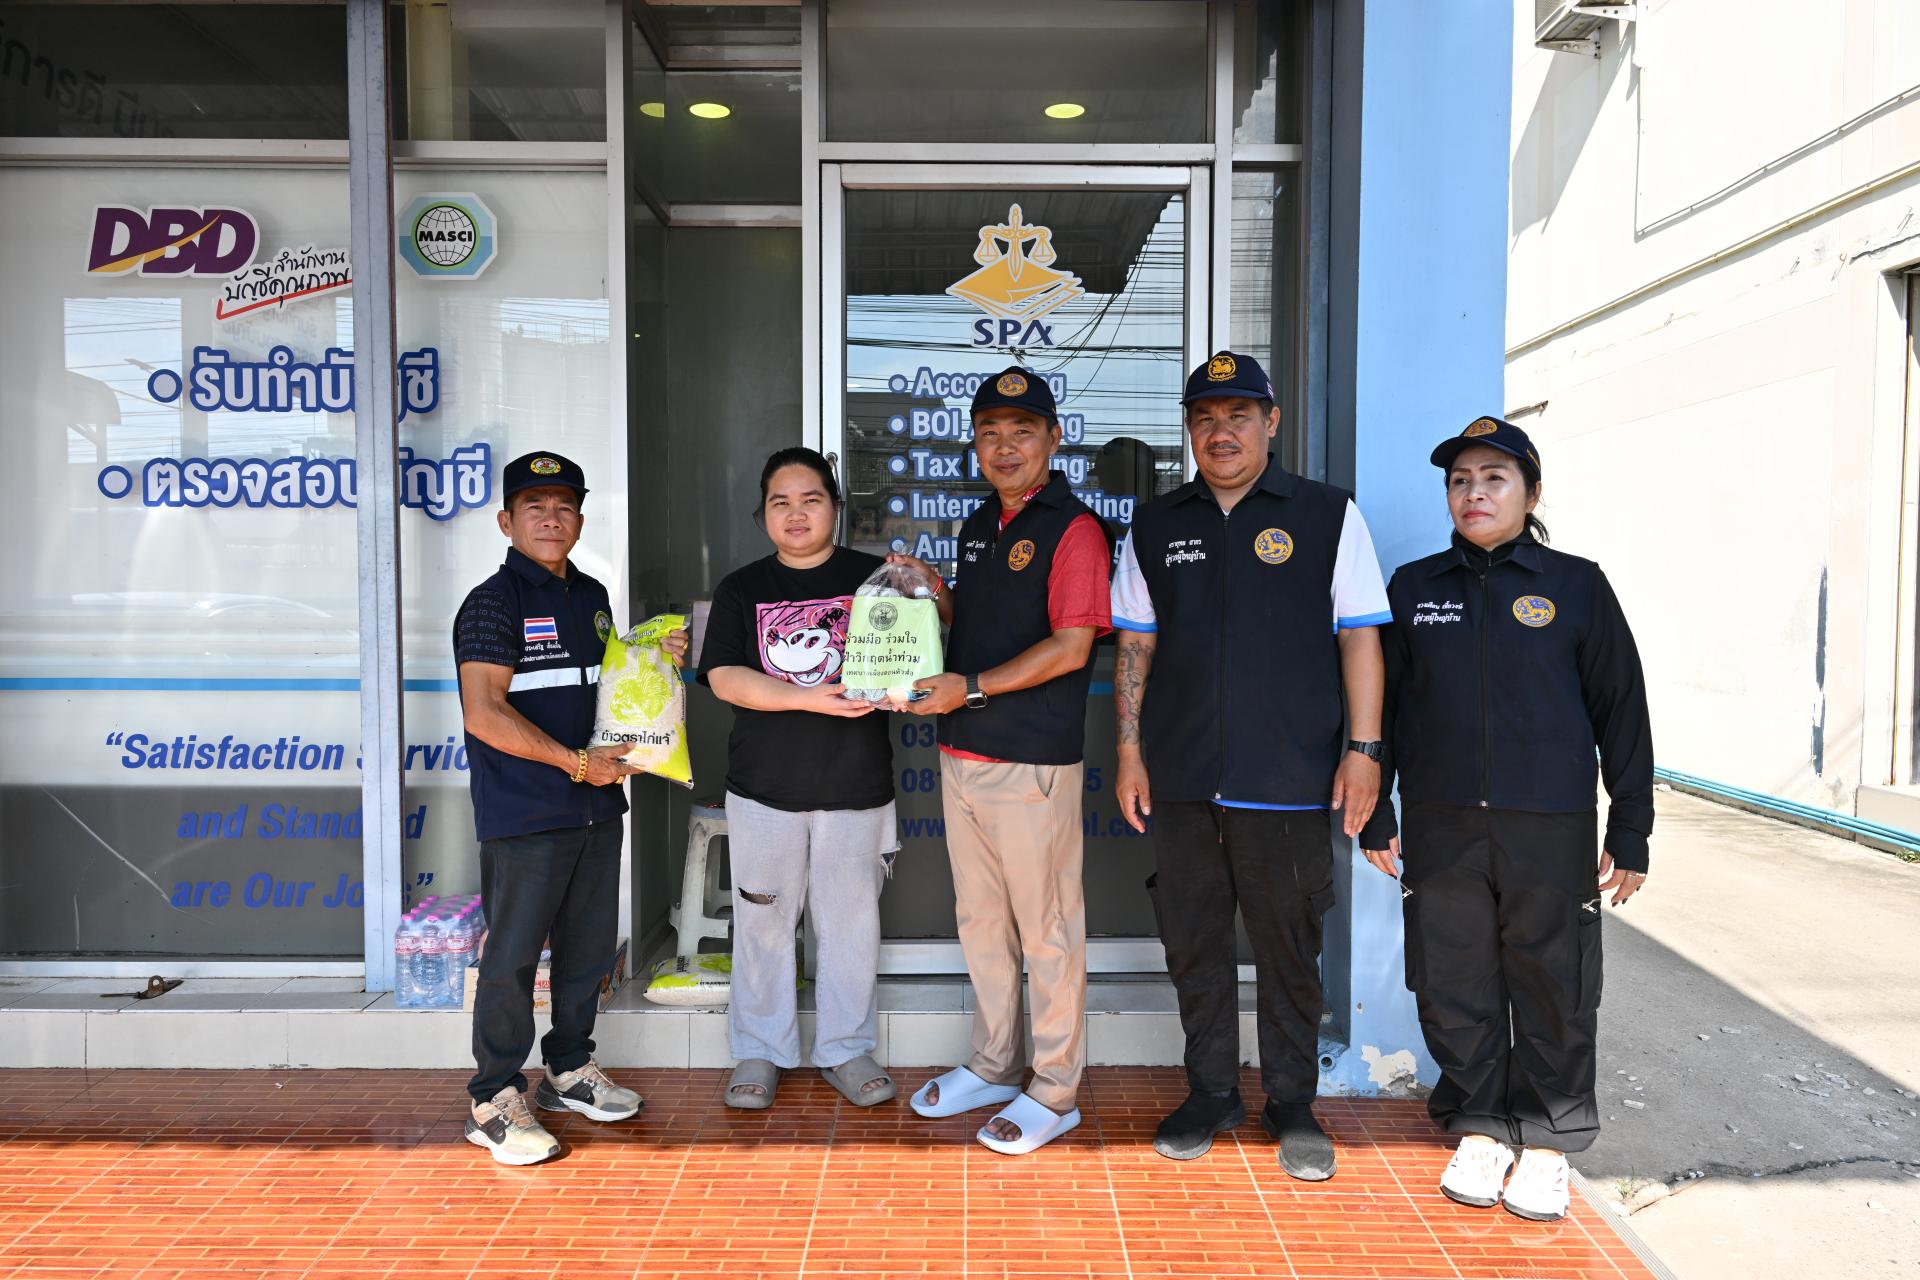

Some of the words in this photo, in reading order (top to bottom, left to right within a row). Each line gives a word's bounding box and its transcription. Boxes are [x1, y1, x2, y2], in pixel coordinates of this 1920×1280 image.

[87, 207, 257, 275] DBD
[418, 229, 473, 244] MASCI
[274, 246, 345, 274] สำนักงาน
[225, 267, 350, 309] บัญชีคุณภาพ
[973, 318, 1054, 346] SPA
[911, 409, 960, 438] BOI
[910, 450, 962, 480] Tax
[886, 630, 917, 645] ร่วมใจ
[602, 729, 671, 745] ข้าวตราไก่แจ้
[178, 803, 246, 839] and
[171, 879, 234, 907] are
[243, 874, 314, 908] Our
